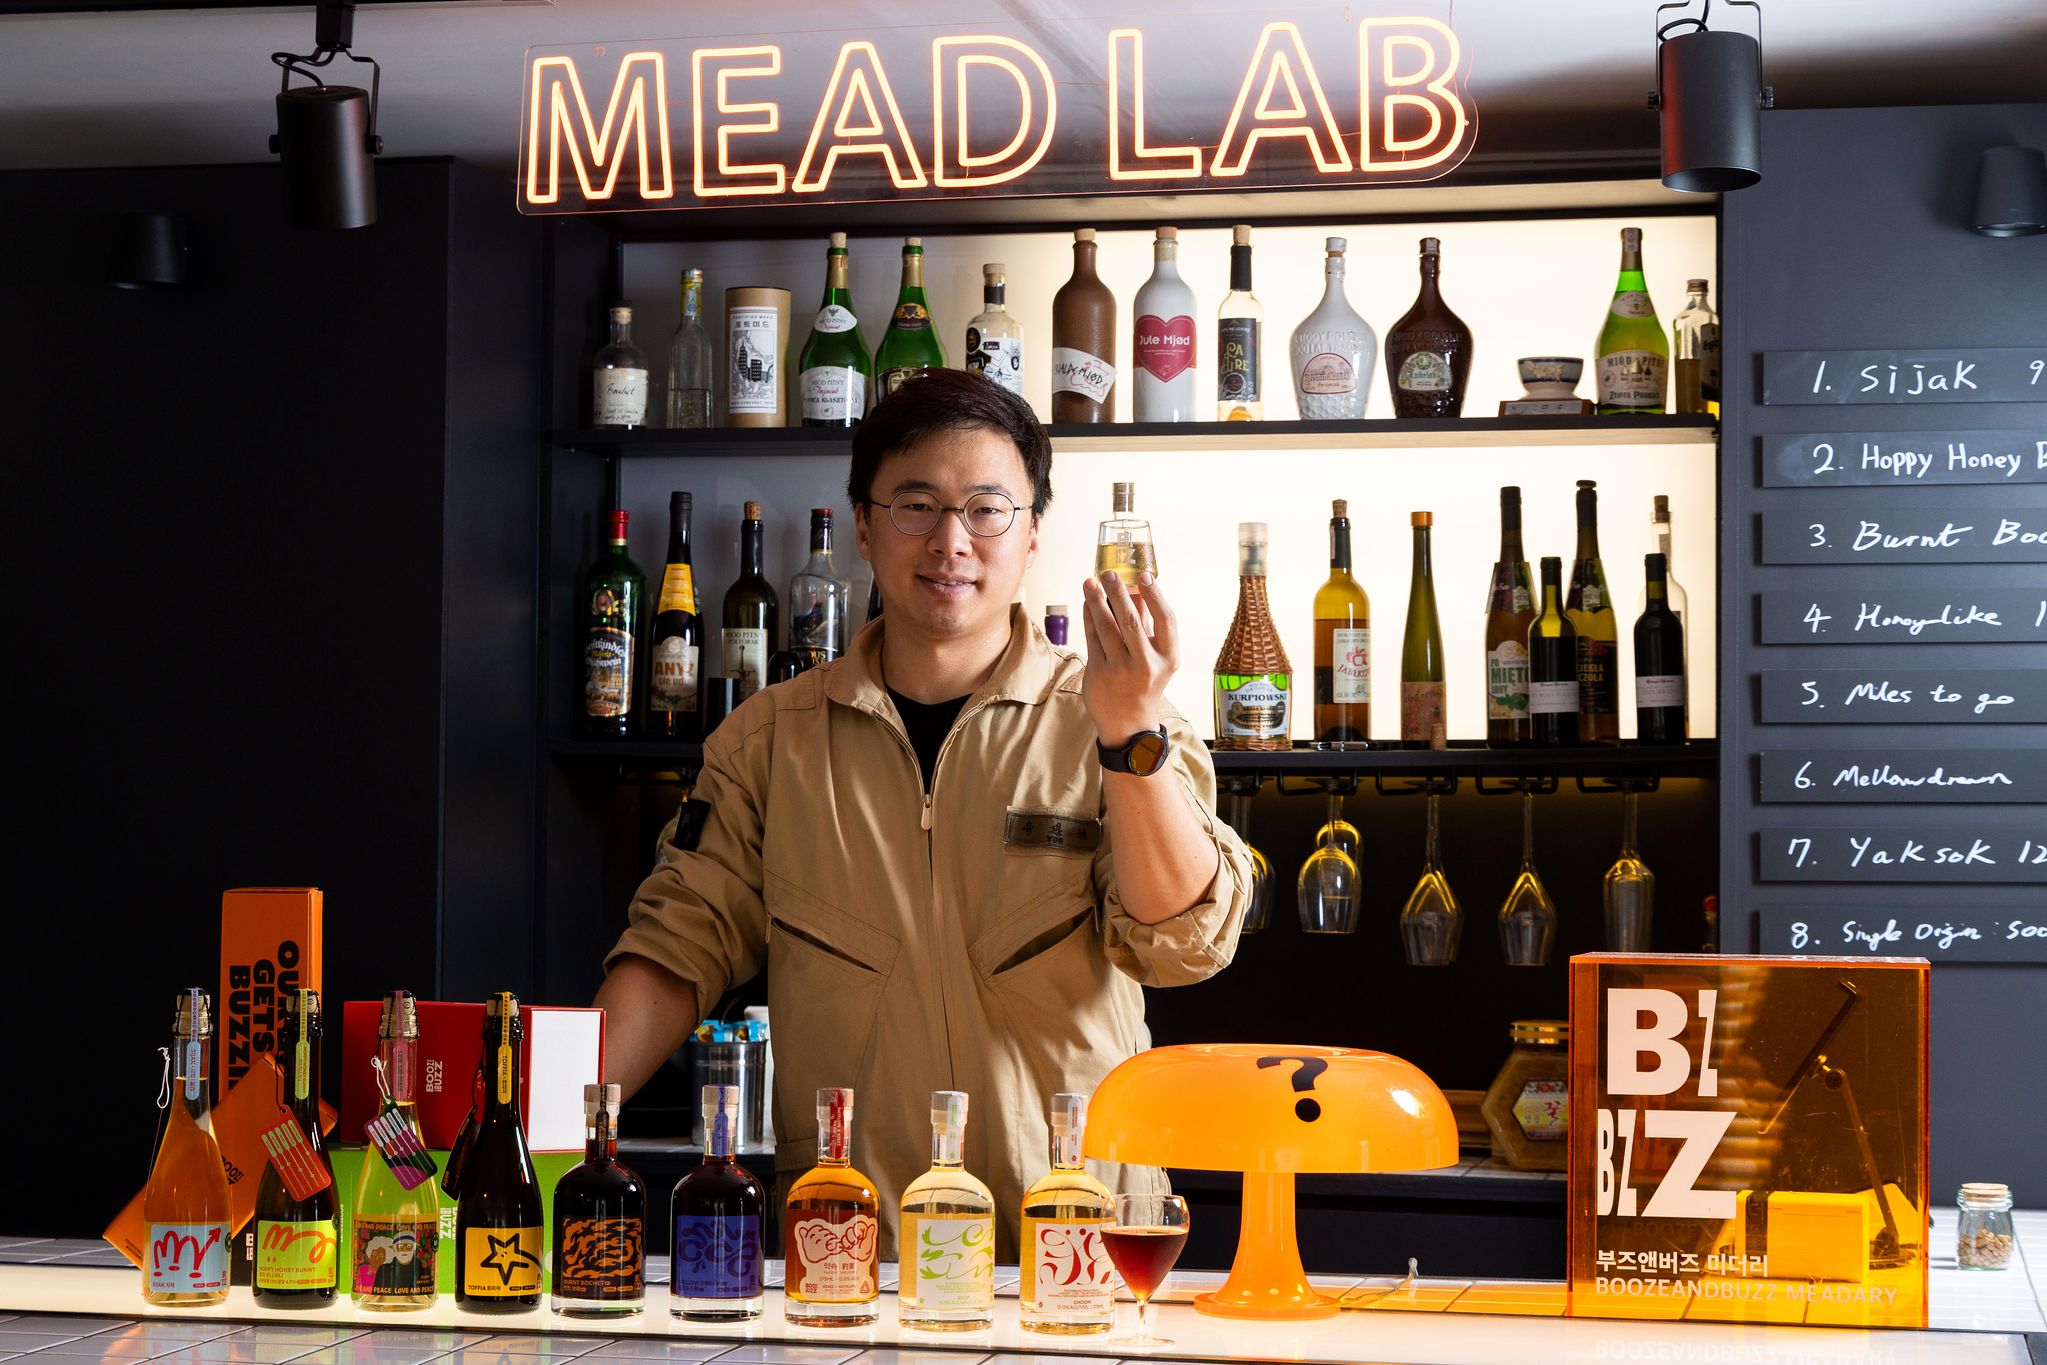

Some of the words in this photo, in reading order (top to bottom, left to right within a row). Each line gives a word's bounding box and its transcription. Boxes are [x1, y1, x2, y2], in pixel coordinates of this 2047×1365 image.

[527, 34, 1057, 205] MEAD
[1108, 17, 1469, 181] LAB
[1139, 335, 1160, 345] Jule
[1163, 335, 1190, 346] Mjød
[1813, 360, 1832, 393] 1.
[1813, 443, 1844, 475] 2.
[1861, 443, 1933, 478] Hoppy
[1948, 443, 2021, 477] Honey
[1809, 523, 1833, 548] 3.
[1852, 520, 1973, 551] Burnt
[1491, 667, 1529, 686] MIĘT
[1801, 681, 1825, 709] 5.
[1845, 681, 1912, 705] Miles
[1930, 684, 1961, 703] to
[1974, 693, 2015, 714] go
[1794, 761, 1816, 789] 6.
[1788, 838, 1818, 868] 7.
[1791, 922, 1821, 949] 8.
[1842, 919, 1902, 951] Single
[1914, 923, 1982, 949] Origin
[252, 959, 275, 1053] GETS
[1596, 1250, 1700, 1274] 부즈앤버즈
[1707, 1253, 1768, 1277] 미더리
[1595, 1276, 1777, 1301] BOOZEANDBUZZ
[1786, 1284, 1898, 1305] MEADARY
